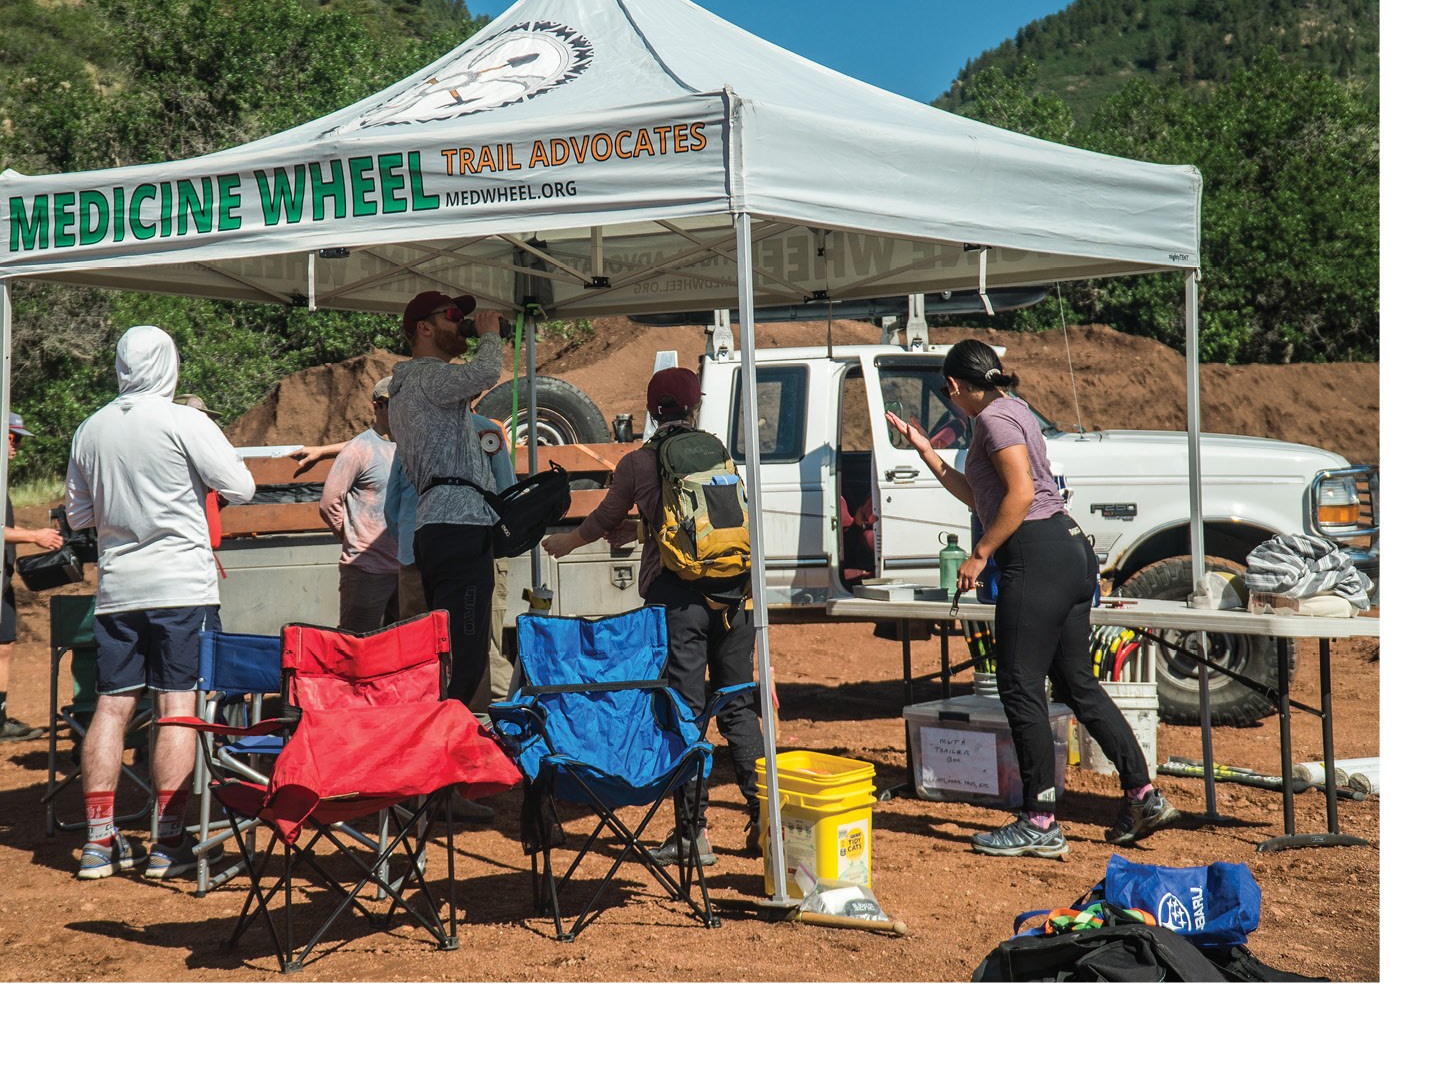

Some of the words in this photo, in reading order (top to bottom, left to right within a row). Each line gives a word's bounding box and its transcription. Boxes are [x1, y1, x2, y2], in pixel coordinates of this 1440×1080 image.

[441, 143, 521, 176] TRAIL
[529, 121, 708, 169] ADVOCATES
[9, 172, 242, 252] MEDICINE
[259, 150, 441, 227] WHEEL
[445, 181, 577, 207] MEDWHEEL.ORG
